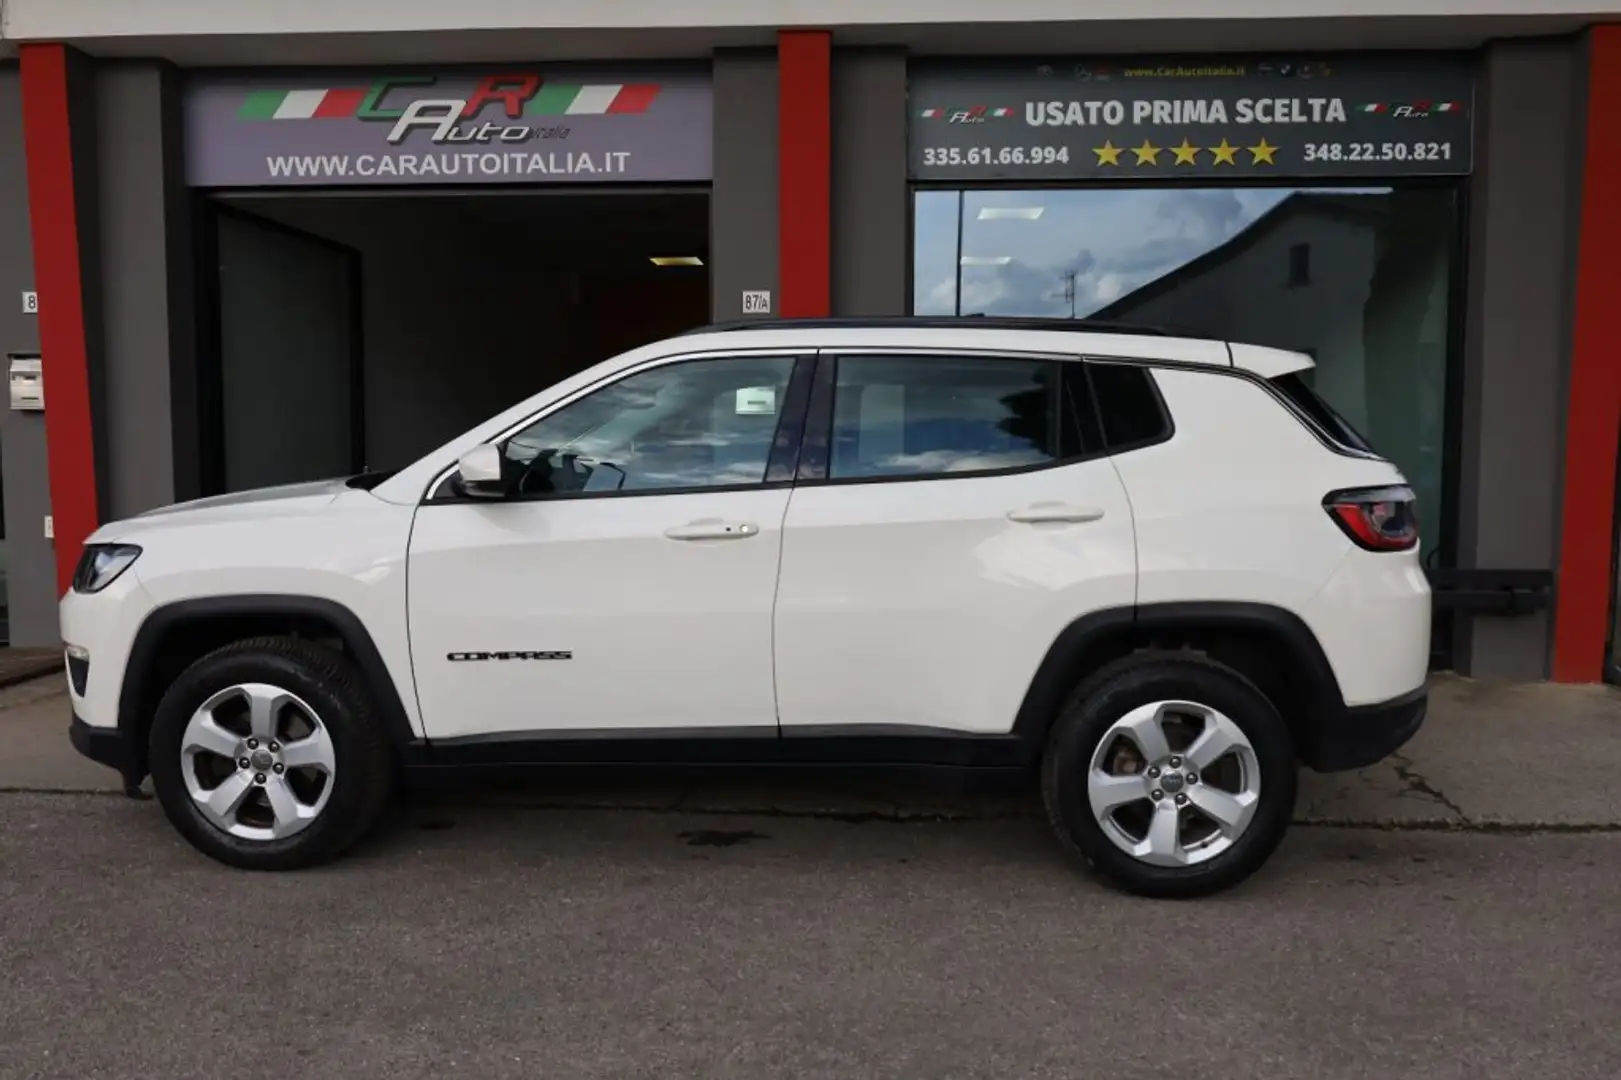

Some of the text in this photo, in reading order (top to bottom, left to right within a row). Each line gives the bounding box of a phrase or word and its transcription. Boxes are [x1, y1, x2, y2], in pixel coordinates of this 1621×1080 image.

[1025, 97, 1347, 126] USATO PRIMA SCELTA
[923, 146, 1070, 166] 335.61.66.994
[1303, 142, 1452, 162] 348.22.50.821
[266, 151, 632, 177] WWW.CARAUTOITALIA.IT
[745, 294, 768, 310] 87/A
[446, 651, 573, 661] COMPASS
